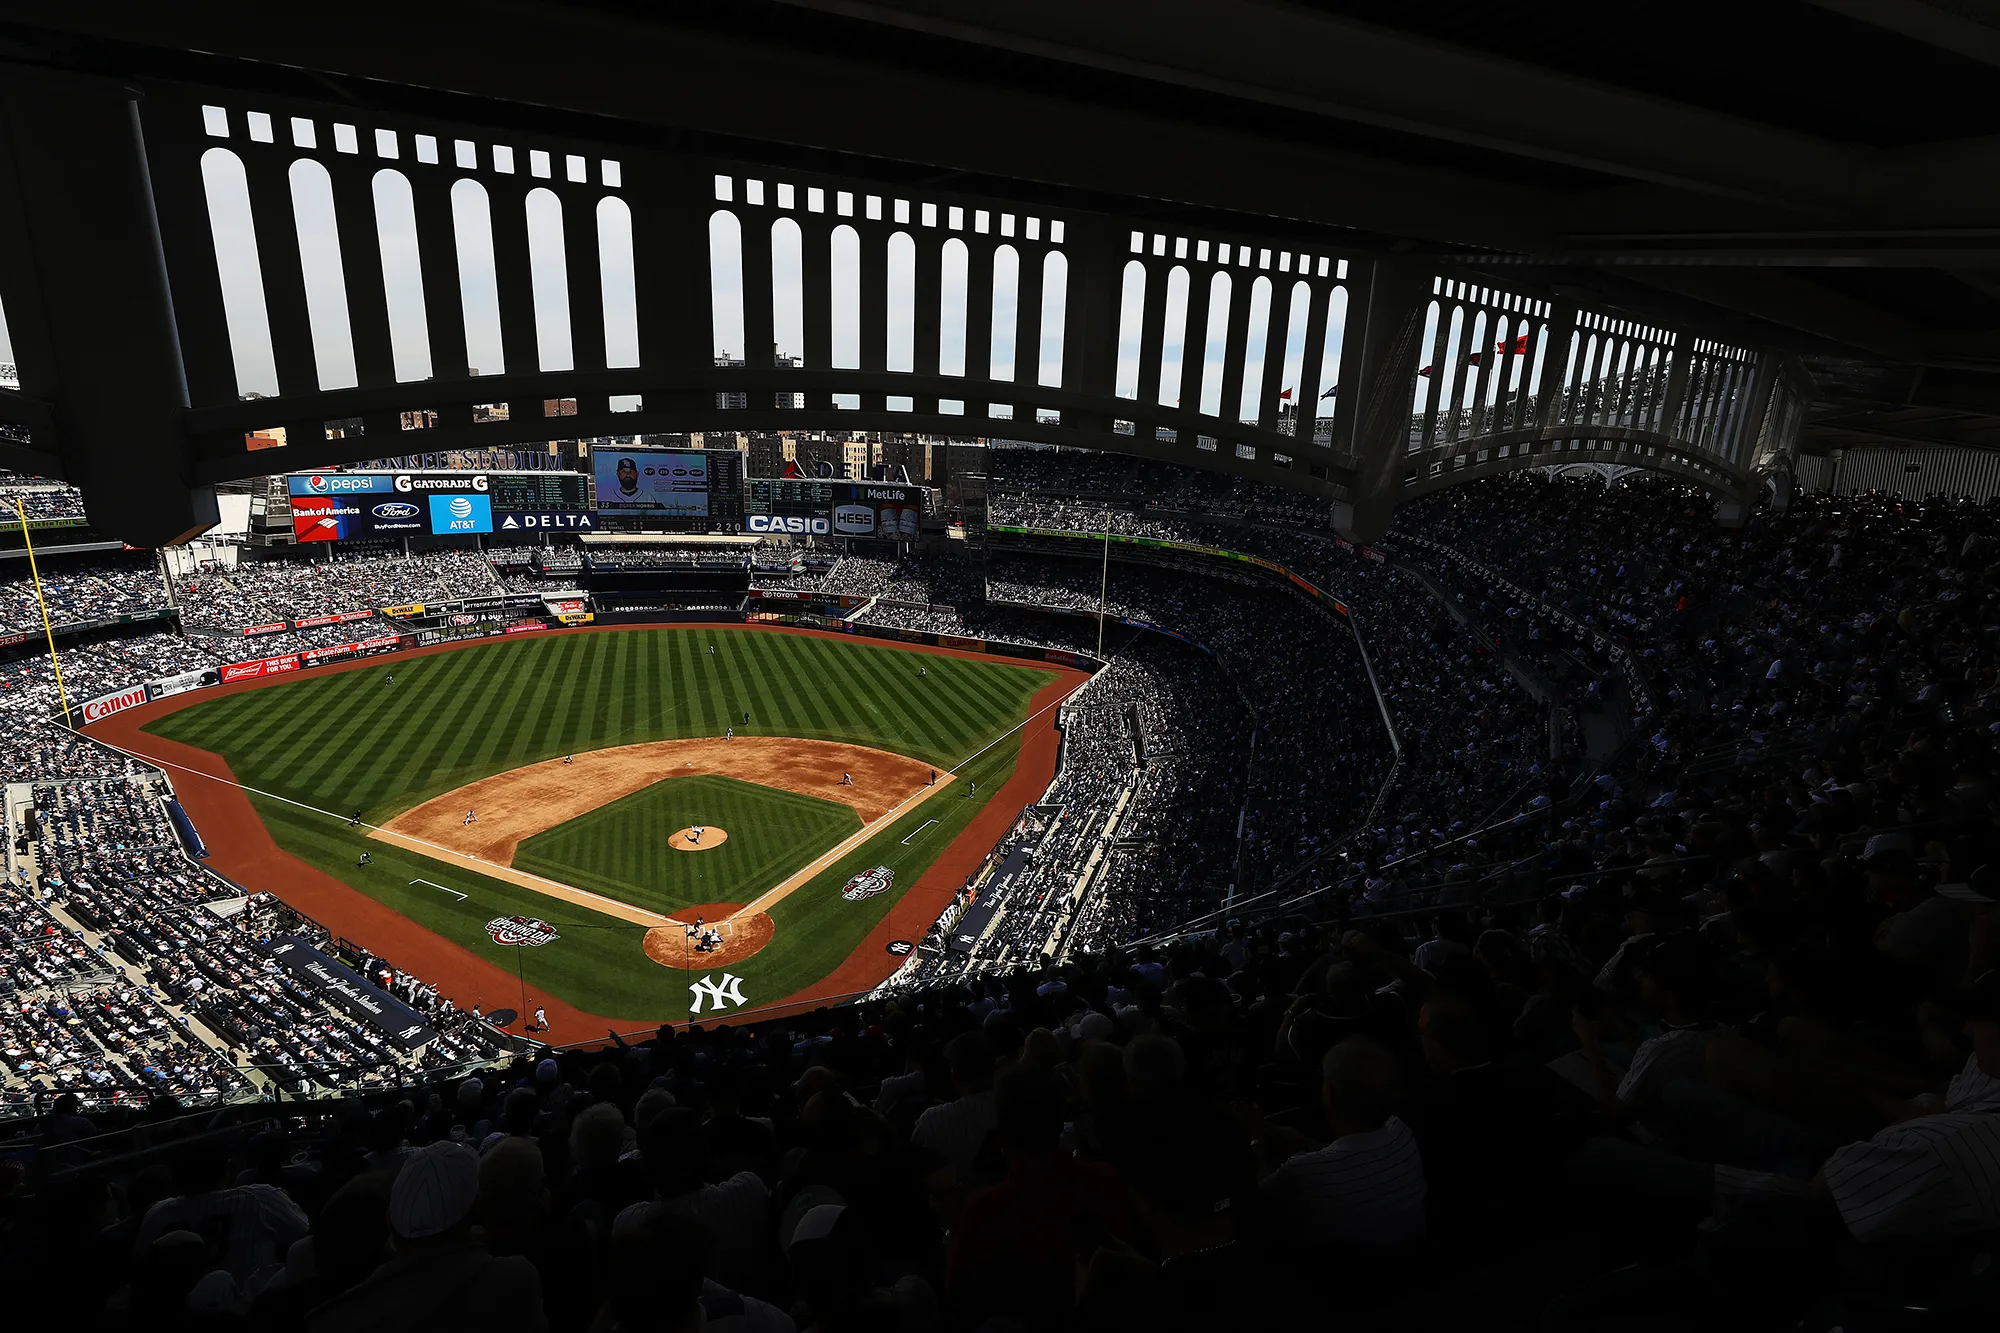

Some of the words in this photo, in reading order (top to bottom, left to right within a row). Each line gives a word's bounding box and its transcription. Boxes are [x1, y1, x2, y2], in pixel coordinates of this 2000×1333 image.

[461, 449, 563, 471] STADIUM
[816, 461, 912, 486] DELTA
[331, 477, 373, 492] pepsi
[413, 477, 471, 490] GATORADE
[867, 489, 906, 500] MetLife
[293, 508, 317, 517] Bank
[326, 506, 360, 515] America
[381, 503, 411, 517] Ford
[449, 520, 475, 529] AT&T
[525, 515, 591, 528] DELTA
[749, 515, 830, 534] CASIO
[837, 512, 872, 525] HESS
[279, 663, 294, 671] YOU.
[282, 656, 298, 665] BUD'S
[85, 689, 147, 720] Canon
[491, 917, 535, 937] OPENING
[532, 930, 560, 943] DAY
[305, 961, 332, 983] Welcome
[326, 979, 361, 999] Yankee
[354, 993, 384, 1015] Stadium
[689, 972, 749, 1014] NY
